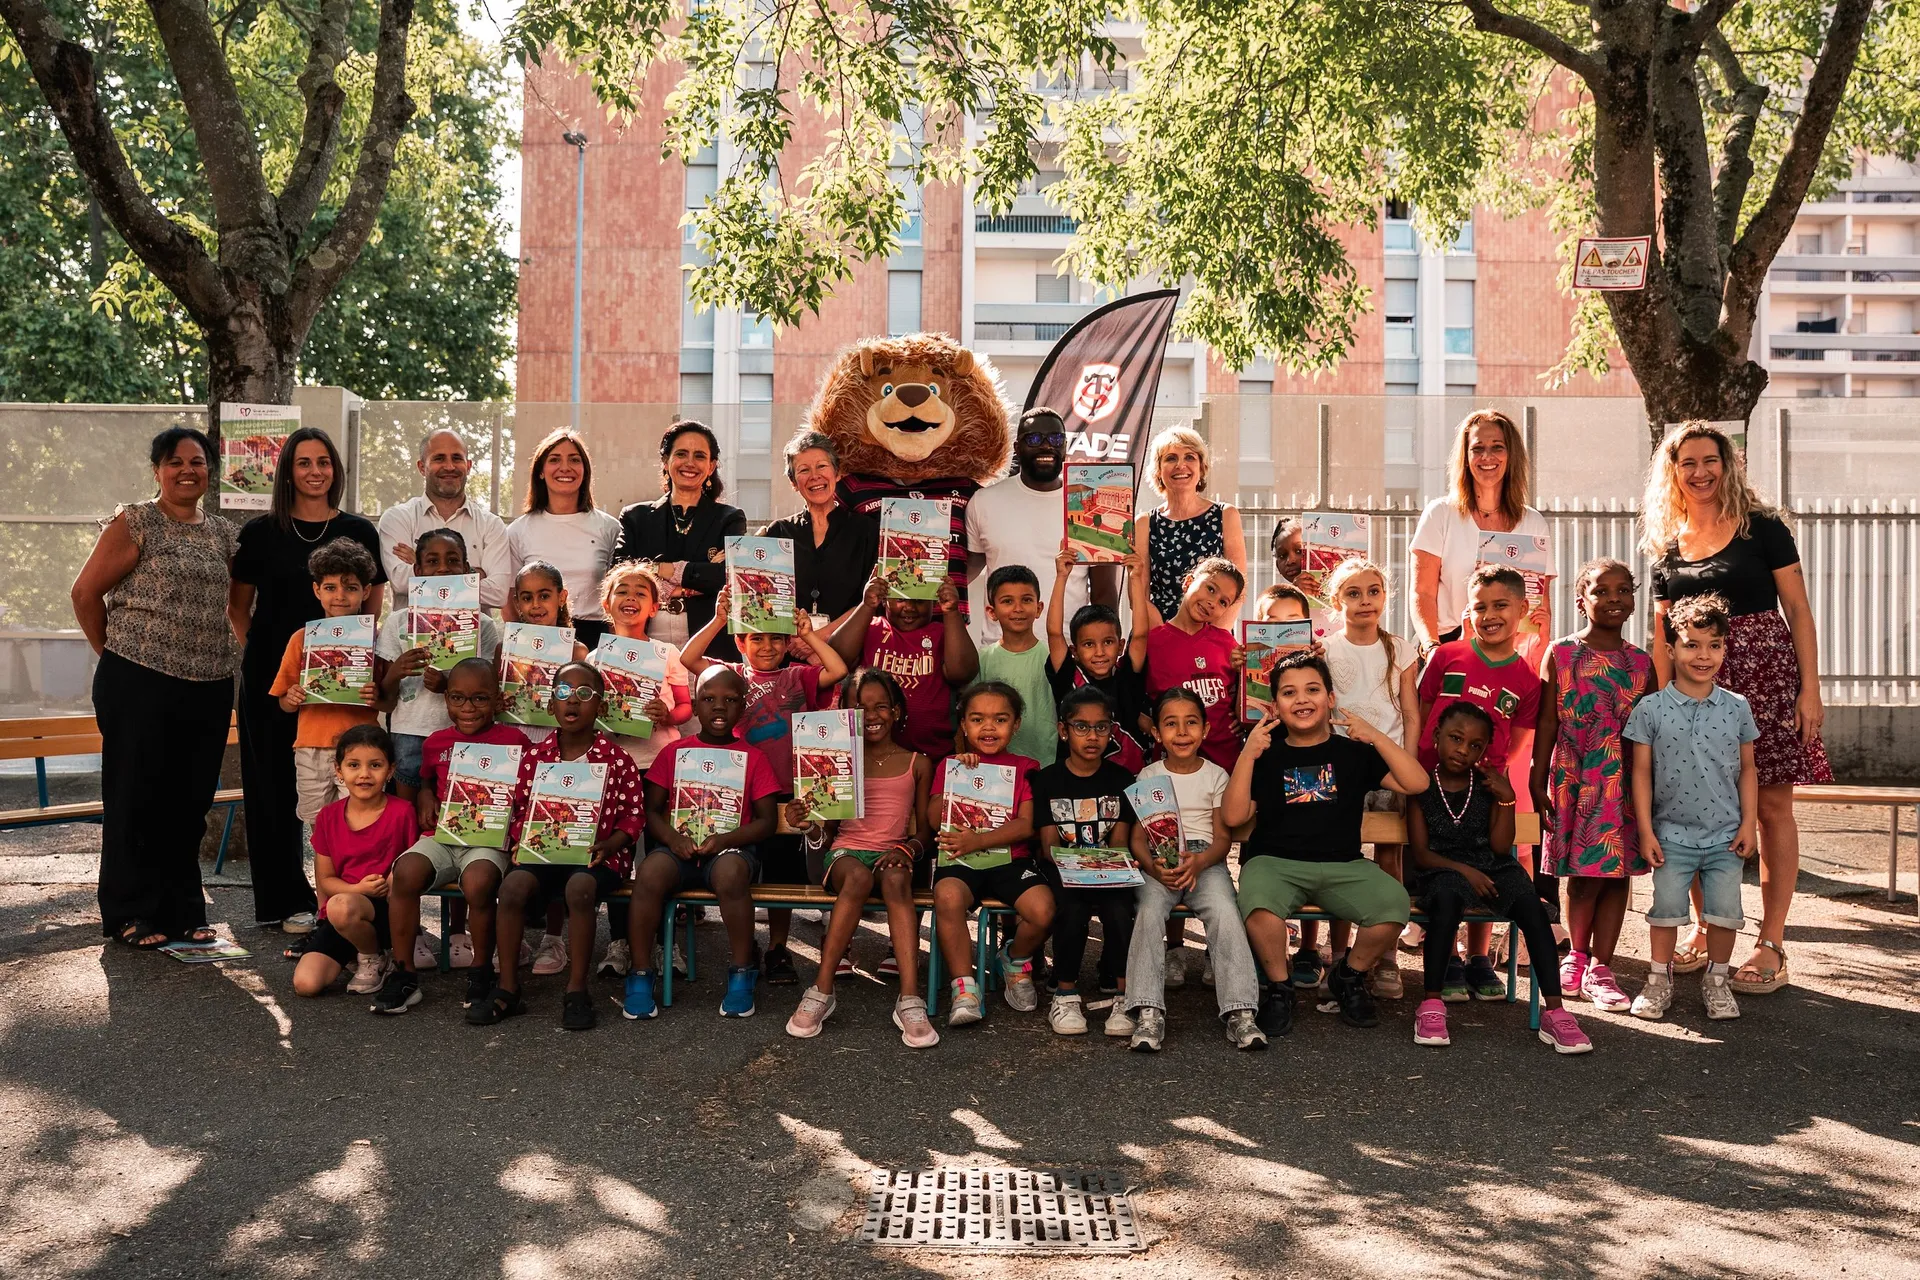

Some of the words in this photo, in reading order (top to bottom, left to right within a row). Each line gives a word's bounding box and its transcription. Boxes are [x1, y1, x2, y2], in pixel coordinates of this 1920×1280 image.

[1066, 432, 1130, 458] TADE
[881, 630, 892, 644] 7
[876, 648, 933, 658] ATHLETIC
[873, 653, 934, 676] LEGEND
[1468, 686, 1489, 698] PUMA
